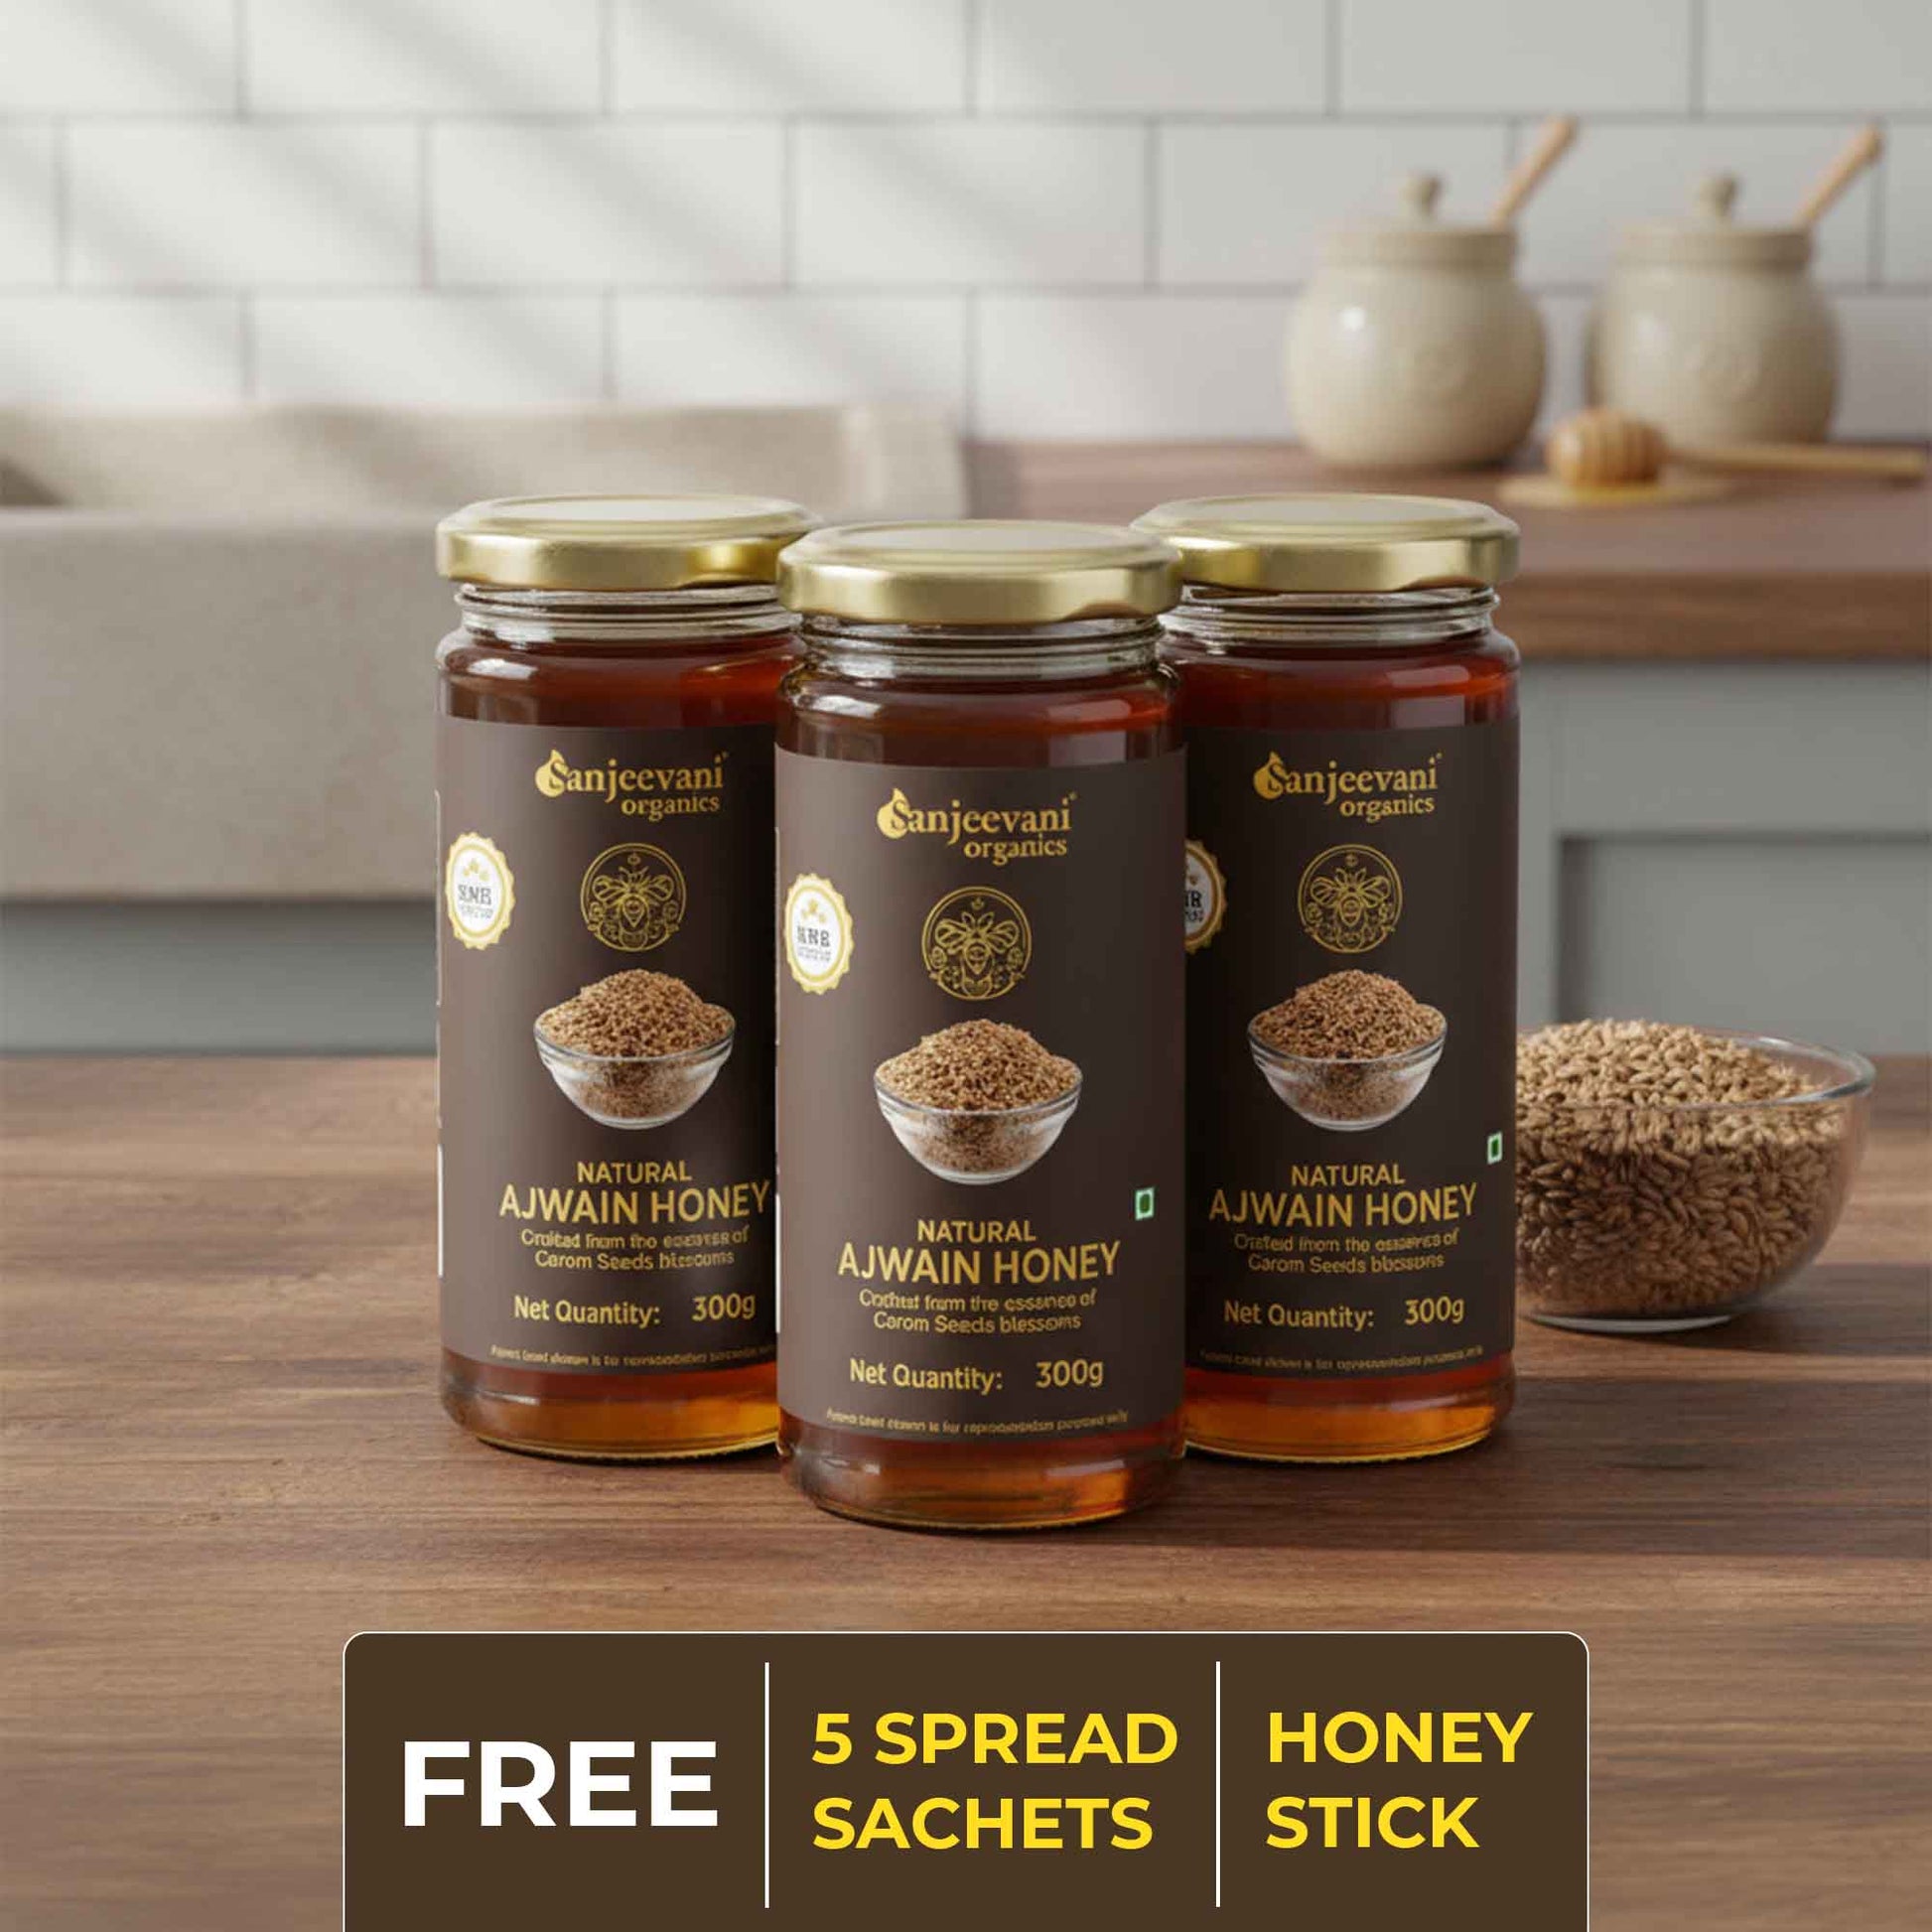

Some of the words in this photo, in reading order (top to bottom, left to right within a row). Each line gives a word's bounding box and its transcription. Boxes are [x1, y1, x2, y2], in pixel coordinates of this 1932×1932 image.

[536, 752, 724, 802] Sanjeevani
[1253, 753, 1438, 804] Sanjeevani
[621, 796, 720, 822] organics
[878, 790, 1071, 846] Sanjeevani
[1340, 794, 1435, 823] organics
[964, 833, 1067, 865] organics
[577, 1161, 692, 1184] NATURAL
[1292, 1164, 1405, 1186] NATURAL
[499, 1184, 637, 1224] AJWAIN
[651, 1180, 770, 1223] HONEY
[1209, 1189, 1351, 1227] AJWAIN
[1365, 1182, 1477, 1226] HONEY
[917, 1219, 1035, 1243] NATURAL
[838, 1242, 980, 1284] AJWAIN
[994, 1241, 1120, 1284] HONEY
[513, 1296, 549, 1320] Net
[555, 1300, 660, 1328] Quantity:
[691, 1294, 756, 1321] 300g
[1224, 1300, 1262, 1324] Net
[1268, 1304, 1374, 1331] Quantity:
[1405, 1297, 1464, 1324] 300g
[850, 1358, 887, 1385] Net
[893, 1364, 1003, 1395] Quantity:
[1035, 1360, 1104, 1388] 300g
